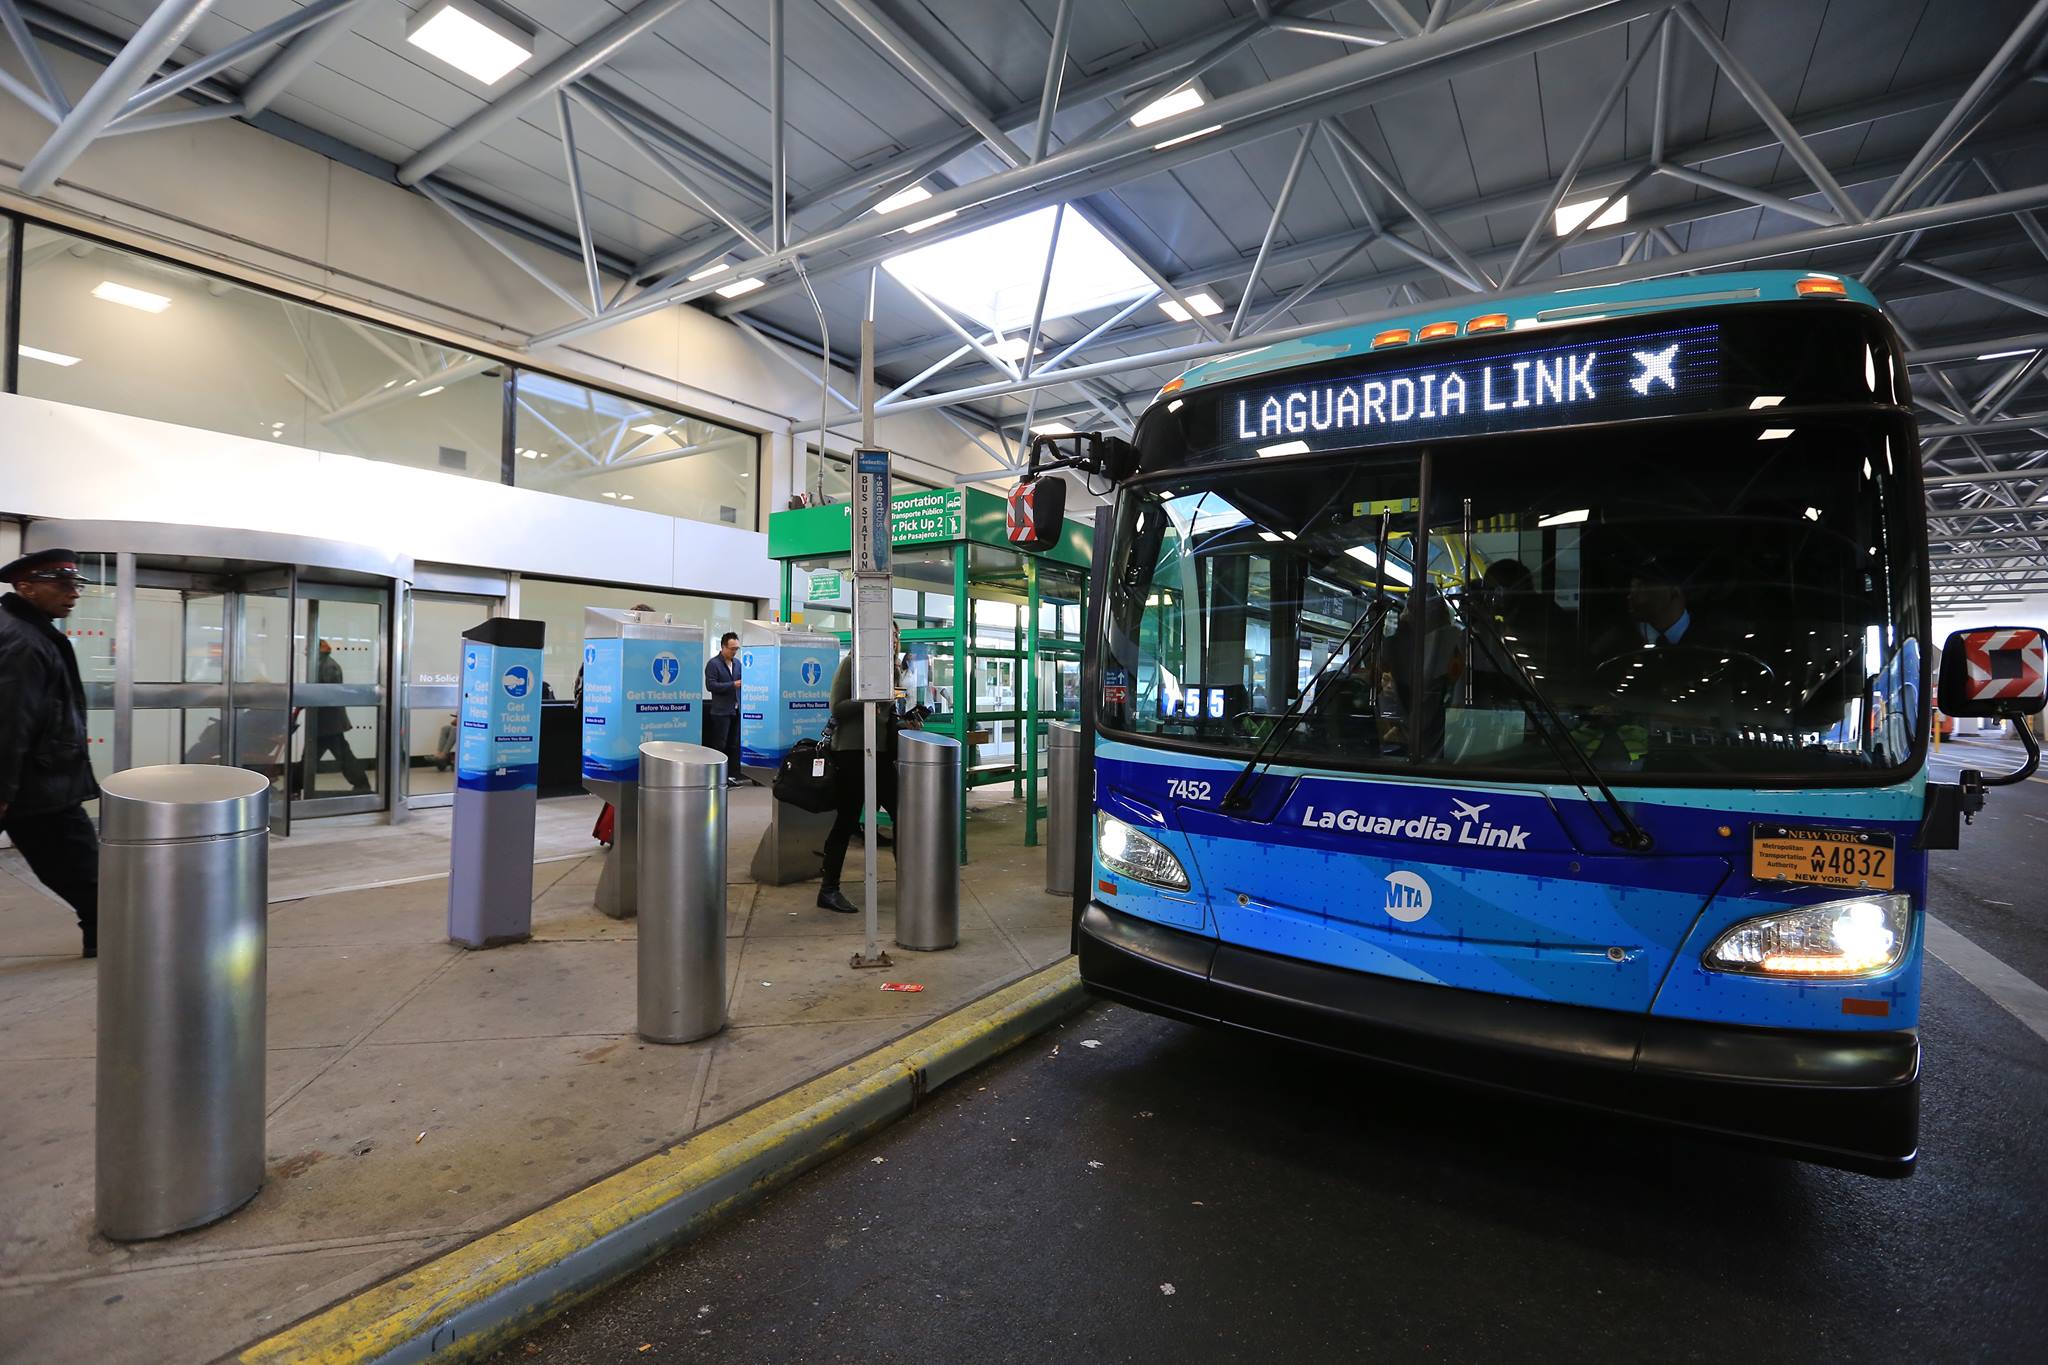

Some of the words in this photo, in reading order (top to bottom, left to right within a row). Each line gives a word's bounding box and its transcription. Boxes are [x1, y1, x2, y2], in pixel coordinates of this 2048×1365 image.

[1239, 371, 1466, 439] LAGUARDIA
[1484, 352, 1596, 411] LINK
[921, 507, 944, 516] Público
[898, 519, 918, 532] Pick
[920, 517, 935, 531] Up
[936, 516, 943, 528] 2
[898, 533, 907, 541] de
[907, 530, 938, 542] Pasajeros
[938, 529, 943, 537] 2
[419, 674, 433, 682] No
[627, 690, 645, 700] Get
[647, 690, 678, 700] Ticket
[679, 690, 701, 700] Here
[783, 690, 797, 698] Get
[798, 690, 820, 698] Ticket
[507, 702, 525, 712] Get
[501, 713, 531, 723] Ticket
[503, 724, 529, 734] Here
[1167, 779, 1211, 801] 7452
[1302, 806, 1453, 841] LaGuardia
[1458, 821, 1532, 850] Link
[1788, 830, 1821, 840] NEW
[1824, 832, 1859, 843] YORK
[1762, 842, 1804, 852] Metropolitan
[1759, 851, 1807, 861] Transportation
[1767, 861, 1798, 870] Authority
[1828, 846, 1886, 878] 4832
[1794, 873, 1818, 882] NEW
[1821, 875, 1849, 884] YORK
[1384, 881, 1423, 908] MTA
